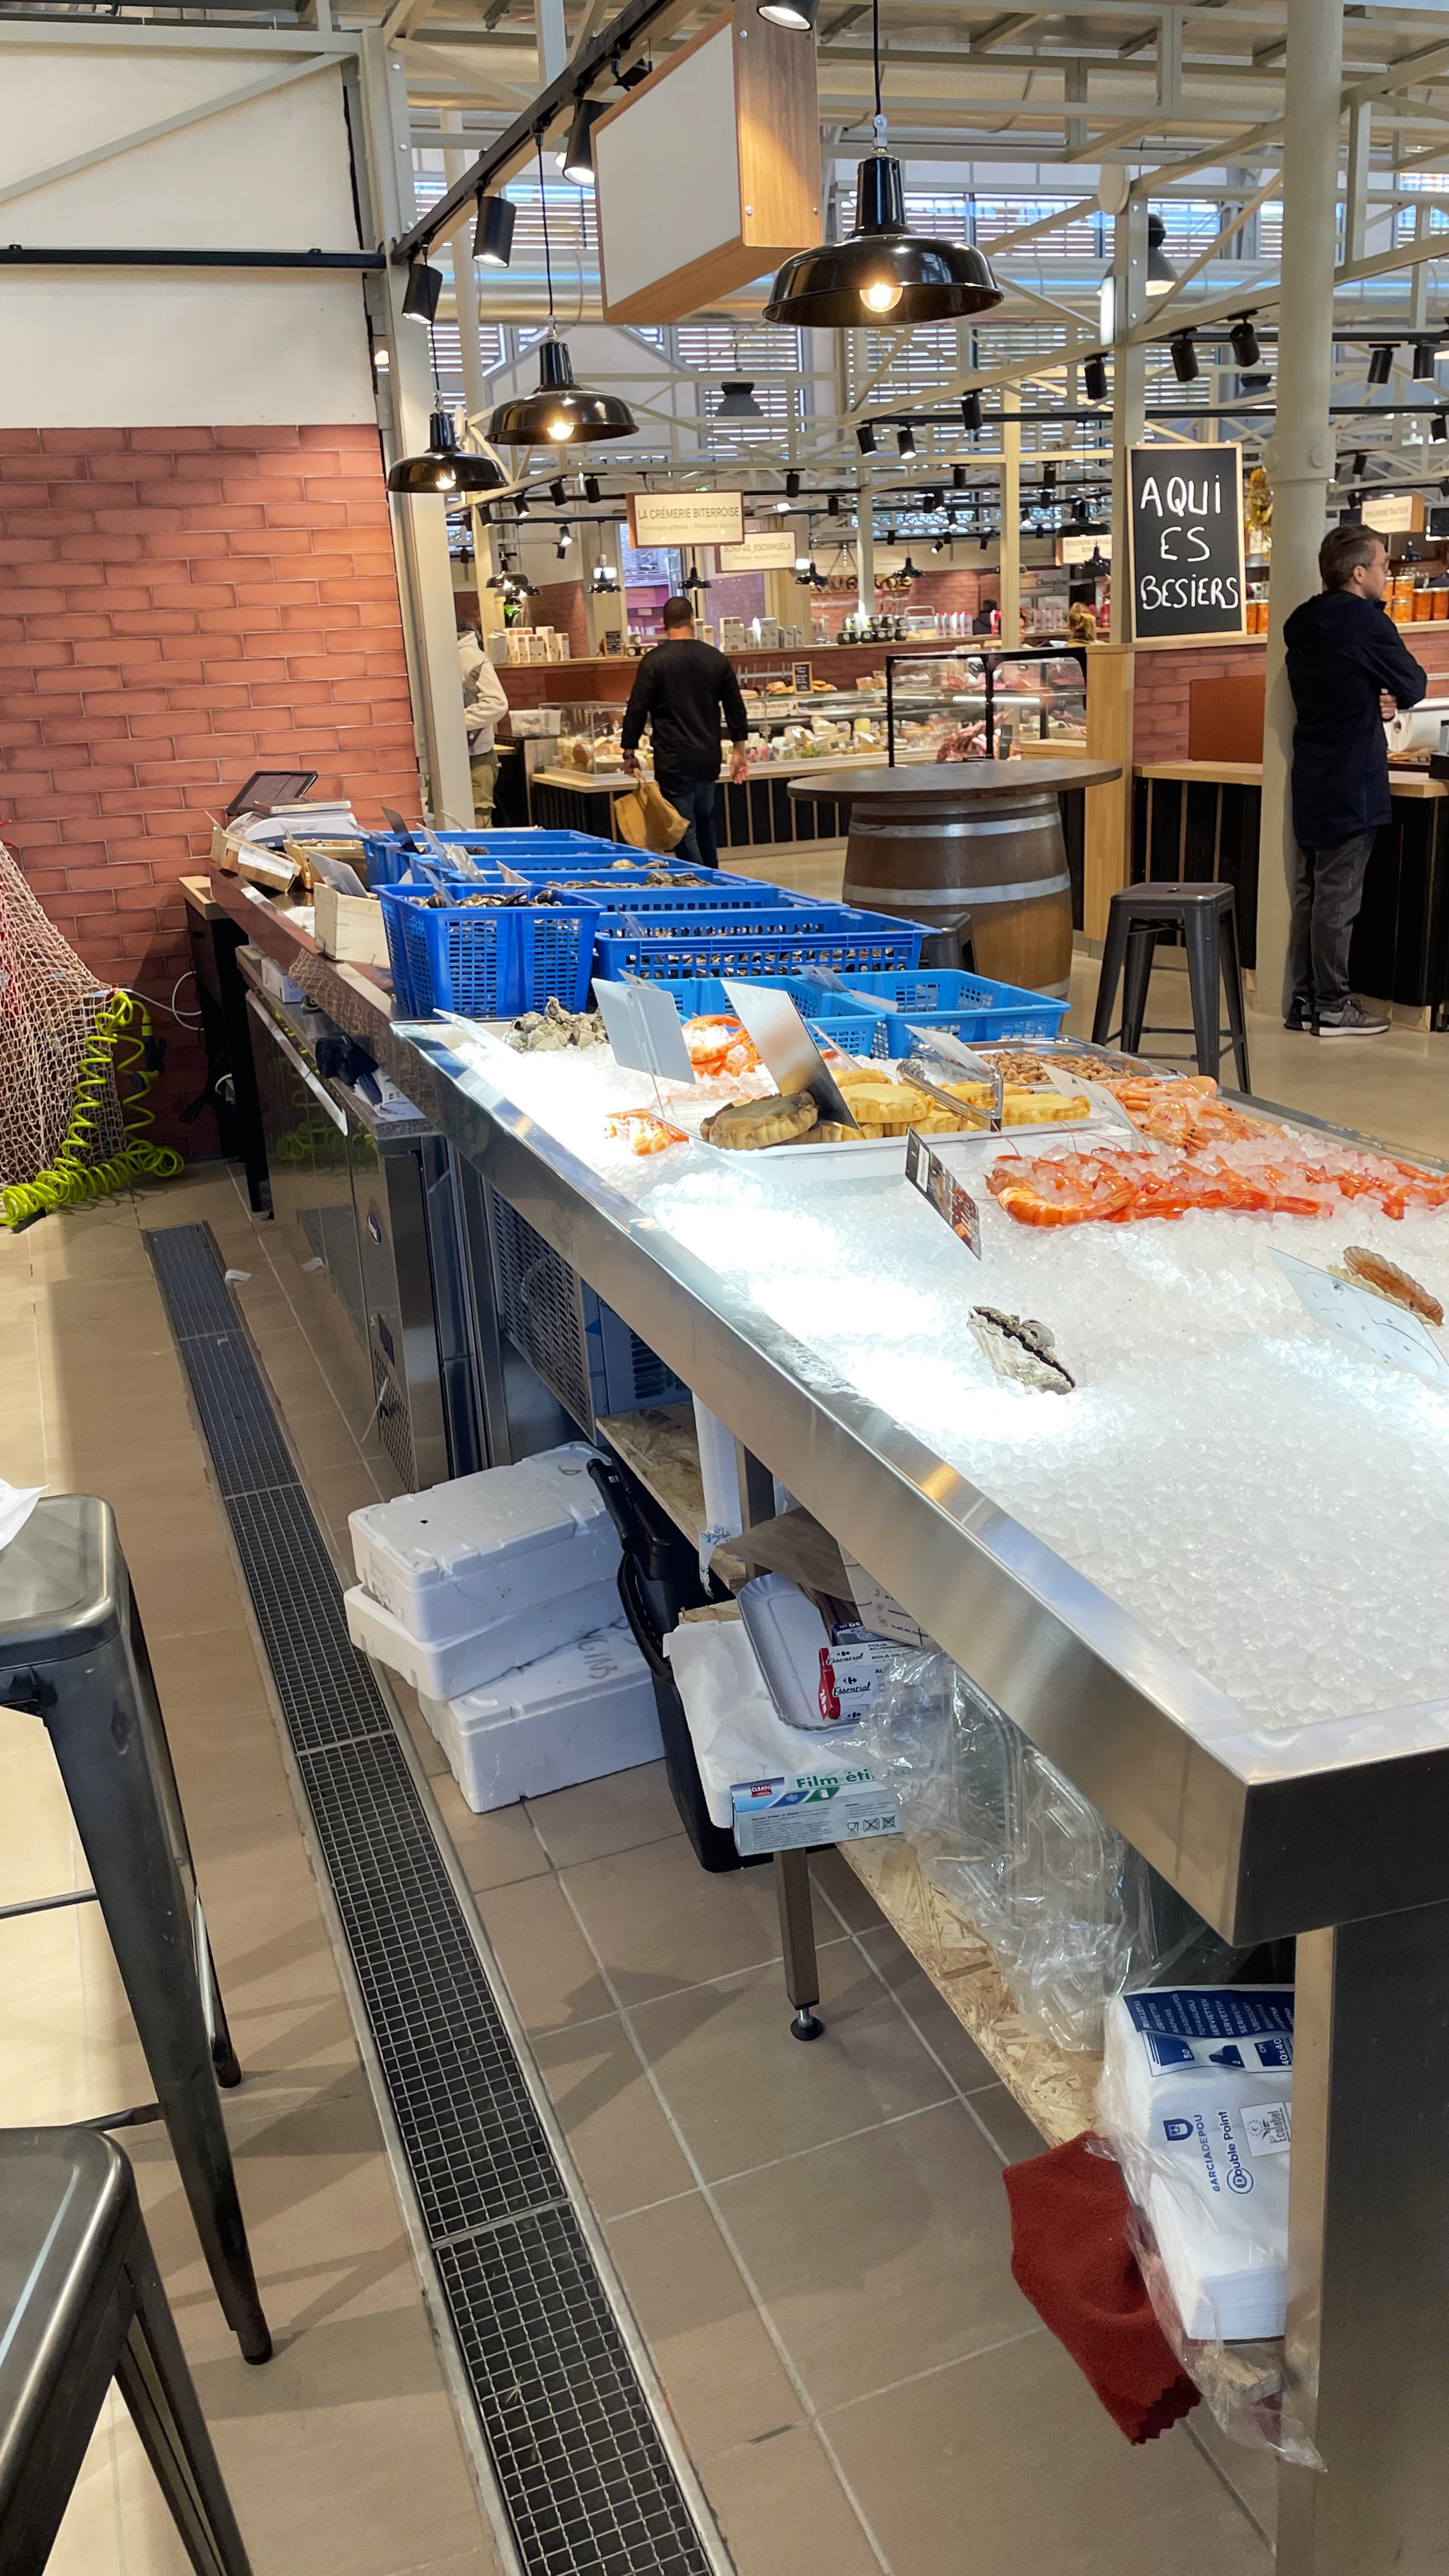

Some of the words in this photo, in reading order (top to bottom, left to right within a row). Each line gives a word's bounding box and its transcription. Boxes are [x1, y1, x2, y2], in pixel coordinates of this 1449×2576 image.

[638, 509, 648, 520] LA
[649, 506, 691, 519] CRÉMERIE
[693, 506, 740, 518] BITERROISE
[1160, 526, 1211, 562] ES
[826, 1652, 864, 1665] Essential
[833, 1681, 871, 1697] Essential
[751, 1784, 771, 1793] CLEAN
[796, 1775, 838, 1789] Film
[1187, 1999, 1206, 2036] TOVAGLIOLI
[1200, 1999, 1221, 2036] SERVIETTEN
[1215, 2000, 1234, 2036] SERVETTEN
[1229, 2003, 1247, 2034] SERWETKI
[1181, 2048, 1192, 2059] 50
[1257, 2043, 1267, 2053] CM
[1273, 2038, 1290, 2066] 40x40
[1217, 2110, 1234, 2141] Point
[1267, 2110, 1287, 2143] Ecolabel
[1193, 2114, 1220, 2192] GARCIADEPOU
[1226, 2142, 1249, 2190] Double
